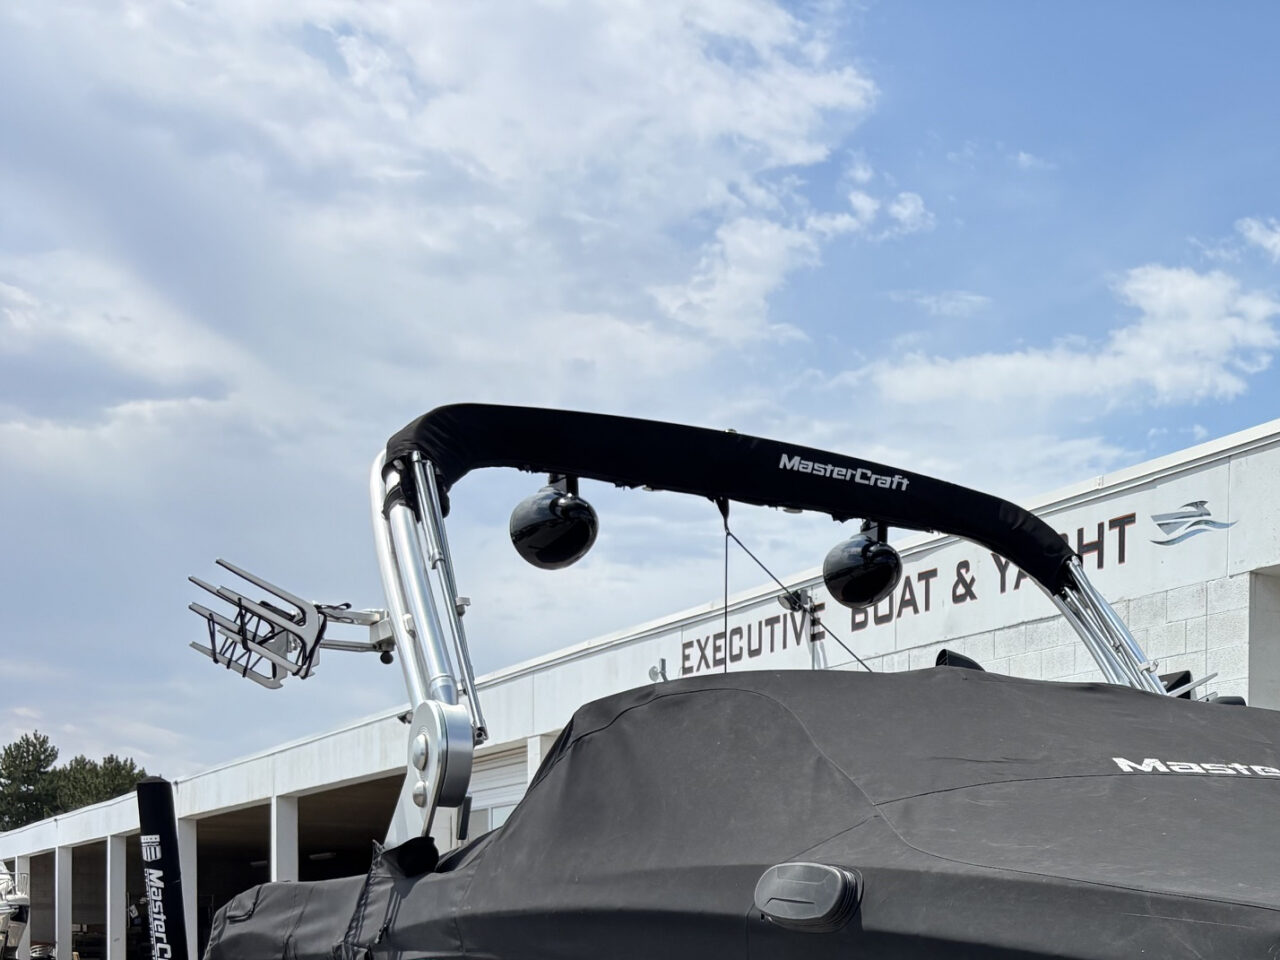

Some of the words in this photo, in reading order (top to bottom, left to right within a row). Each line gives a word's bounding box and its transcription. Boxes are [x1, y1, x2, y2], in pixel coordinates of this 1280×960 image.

[778, 453, 910, 491] MasterCraft
[682, 602, 826, 676] EXECUTIVE
[951, 560, 977, 605] &
[990, 512, 1137, 594] YHT
